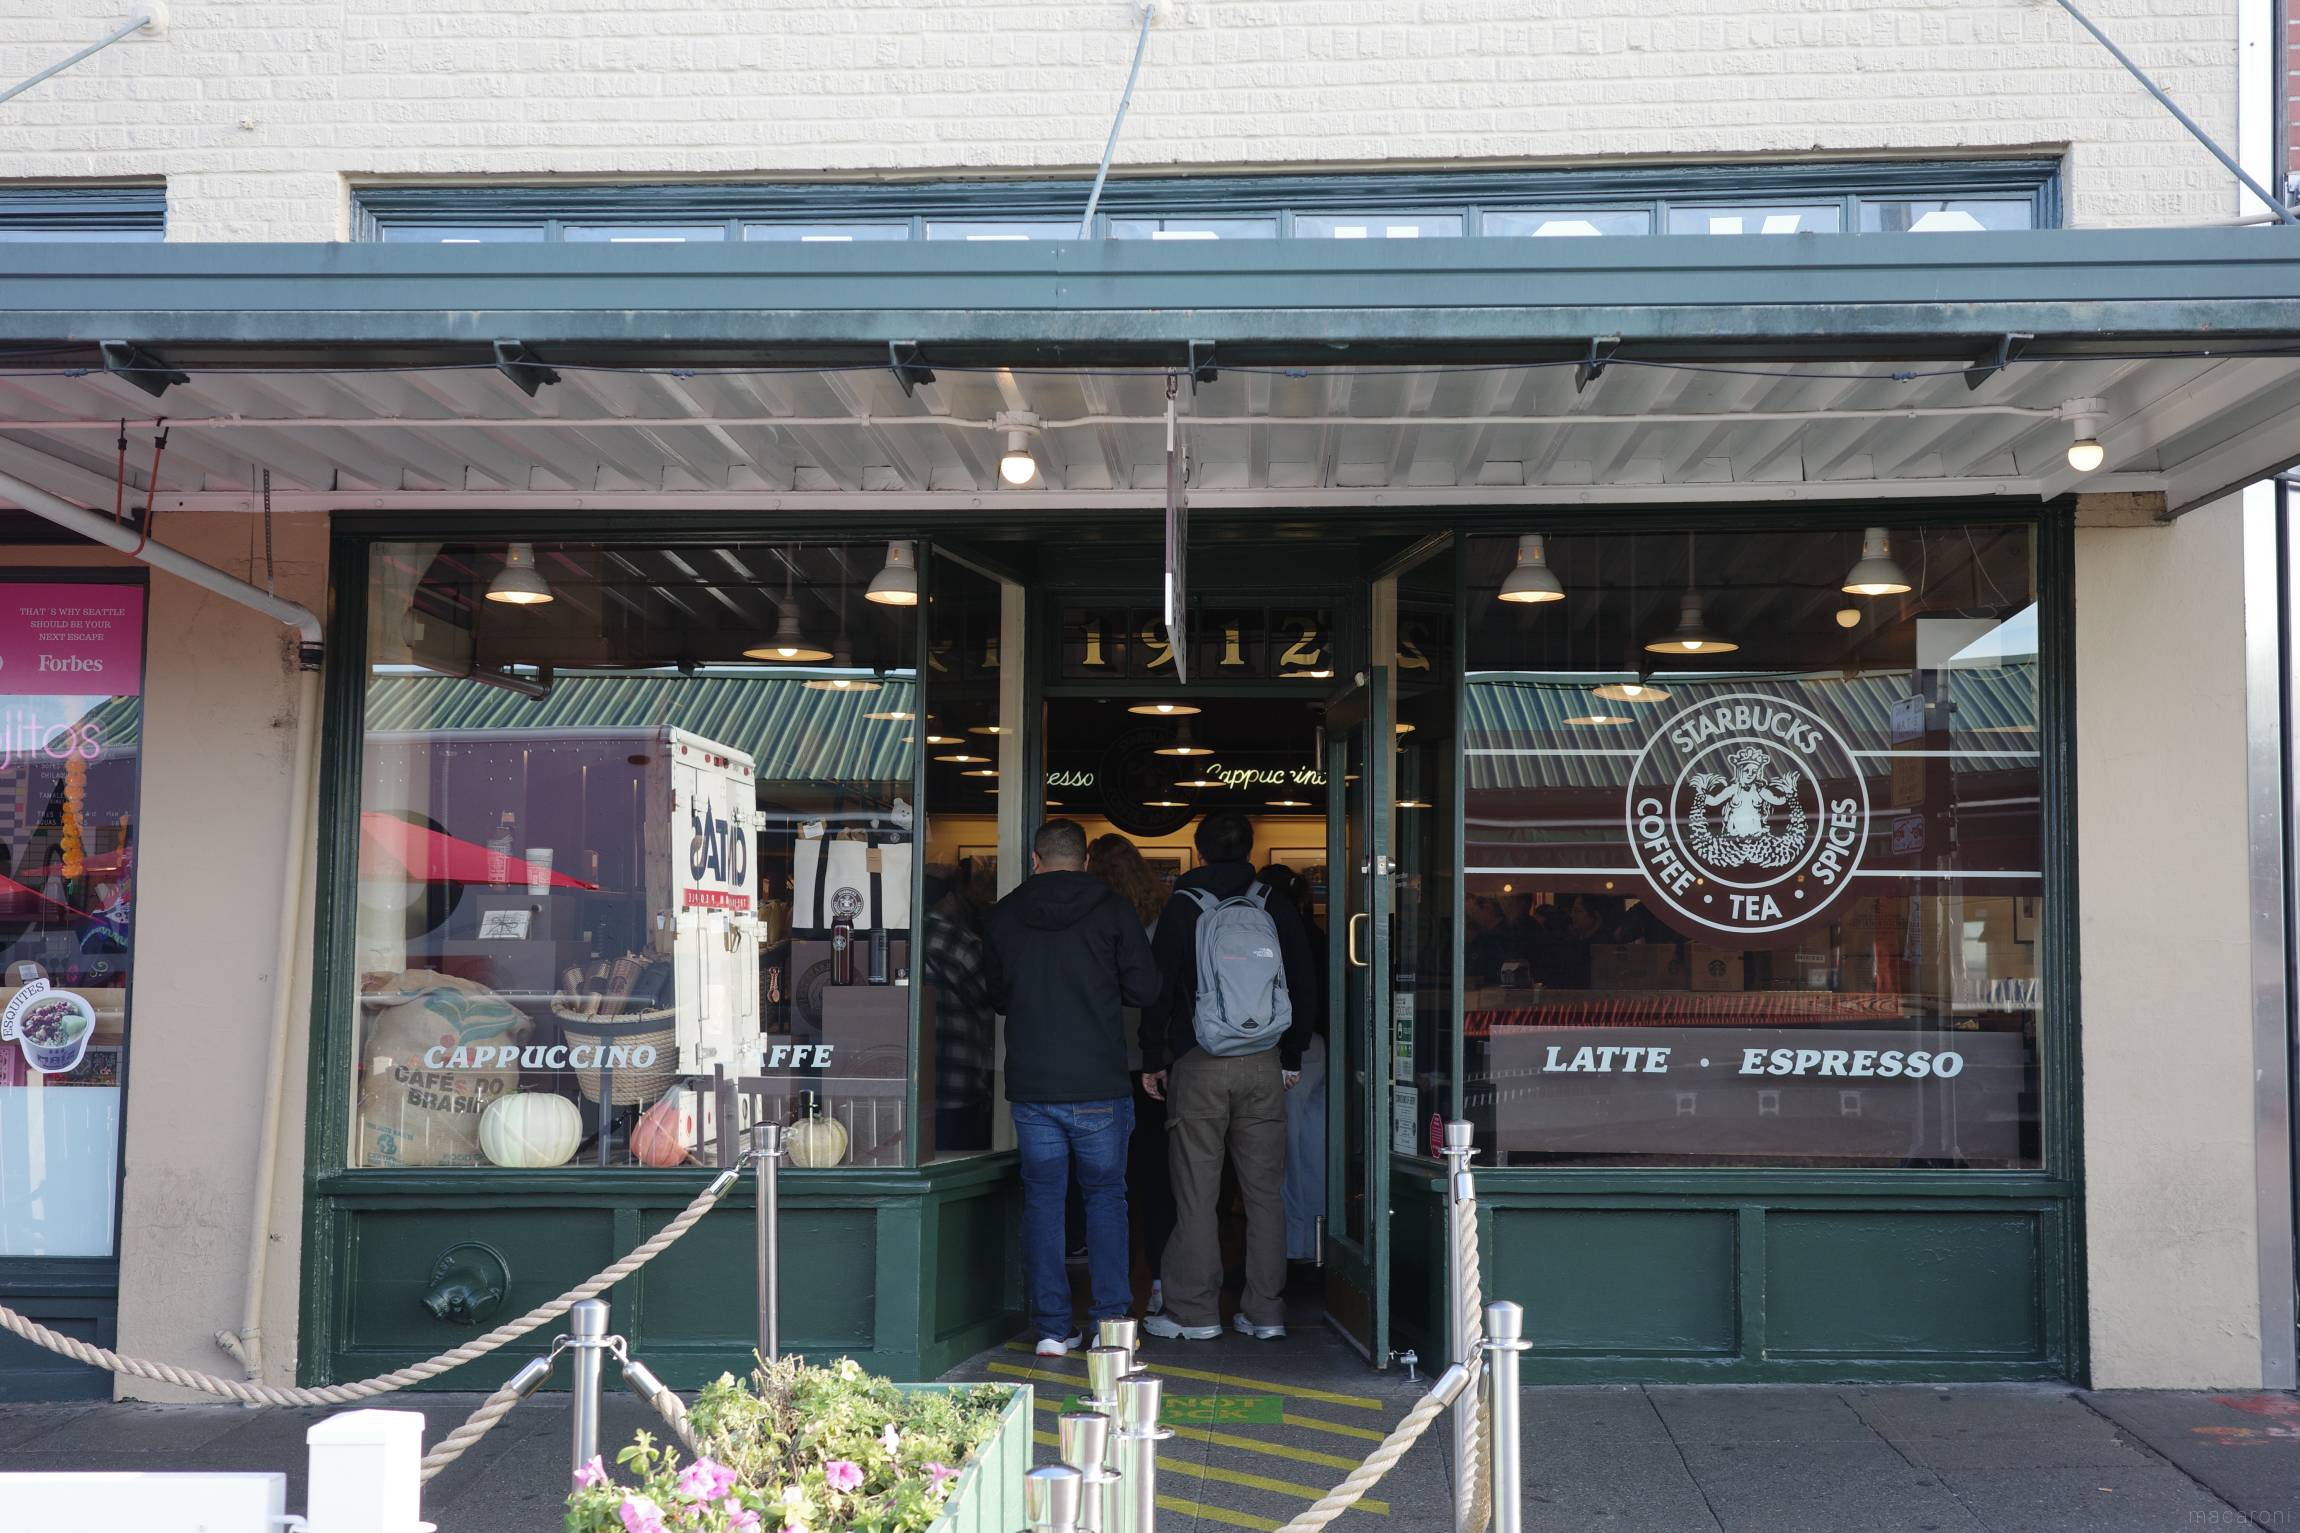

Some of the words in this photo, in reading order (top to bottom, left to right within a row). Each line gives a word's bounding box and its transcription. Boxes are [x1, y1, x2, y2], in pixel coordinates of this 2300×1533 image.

[59, 607, 81, 616] WHY
[82, 608, 126, 616] SEATTLE
[30, 620, 68, 629] SHOULD
[70, 620, 83, 629] BE
[85, 620, 112, 629] YOUR
[39, 632, 66, 641] NEXT
[67, 633, 105, 641] ESCAPE
[38, 654, 104, 672] Forbes
[1671, 705, 1823, 753] STARBUCKS
[0, 709, 101, 770] jitos
[1045, 770, 1095, 787] esso
[1637, 798, 1696, 896] COFFEE
[1729, 893, 1783, 921] TEA
[1811, 798, 1857, 885] SPICES
[3, 981, 45, 1037] ESQUITES
[424, 1044, 657, 1069] CAPPUCCINO
[1542, 1046, 1671, 1073] LATTE
[1738, 1048, 1964, 1078] ESPRESSO
[474, 1078, 505, 1095] DO
[1165, 1398, 1264, 1408] NOT
